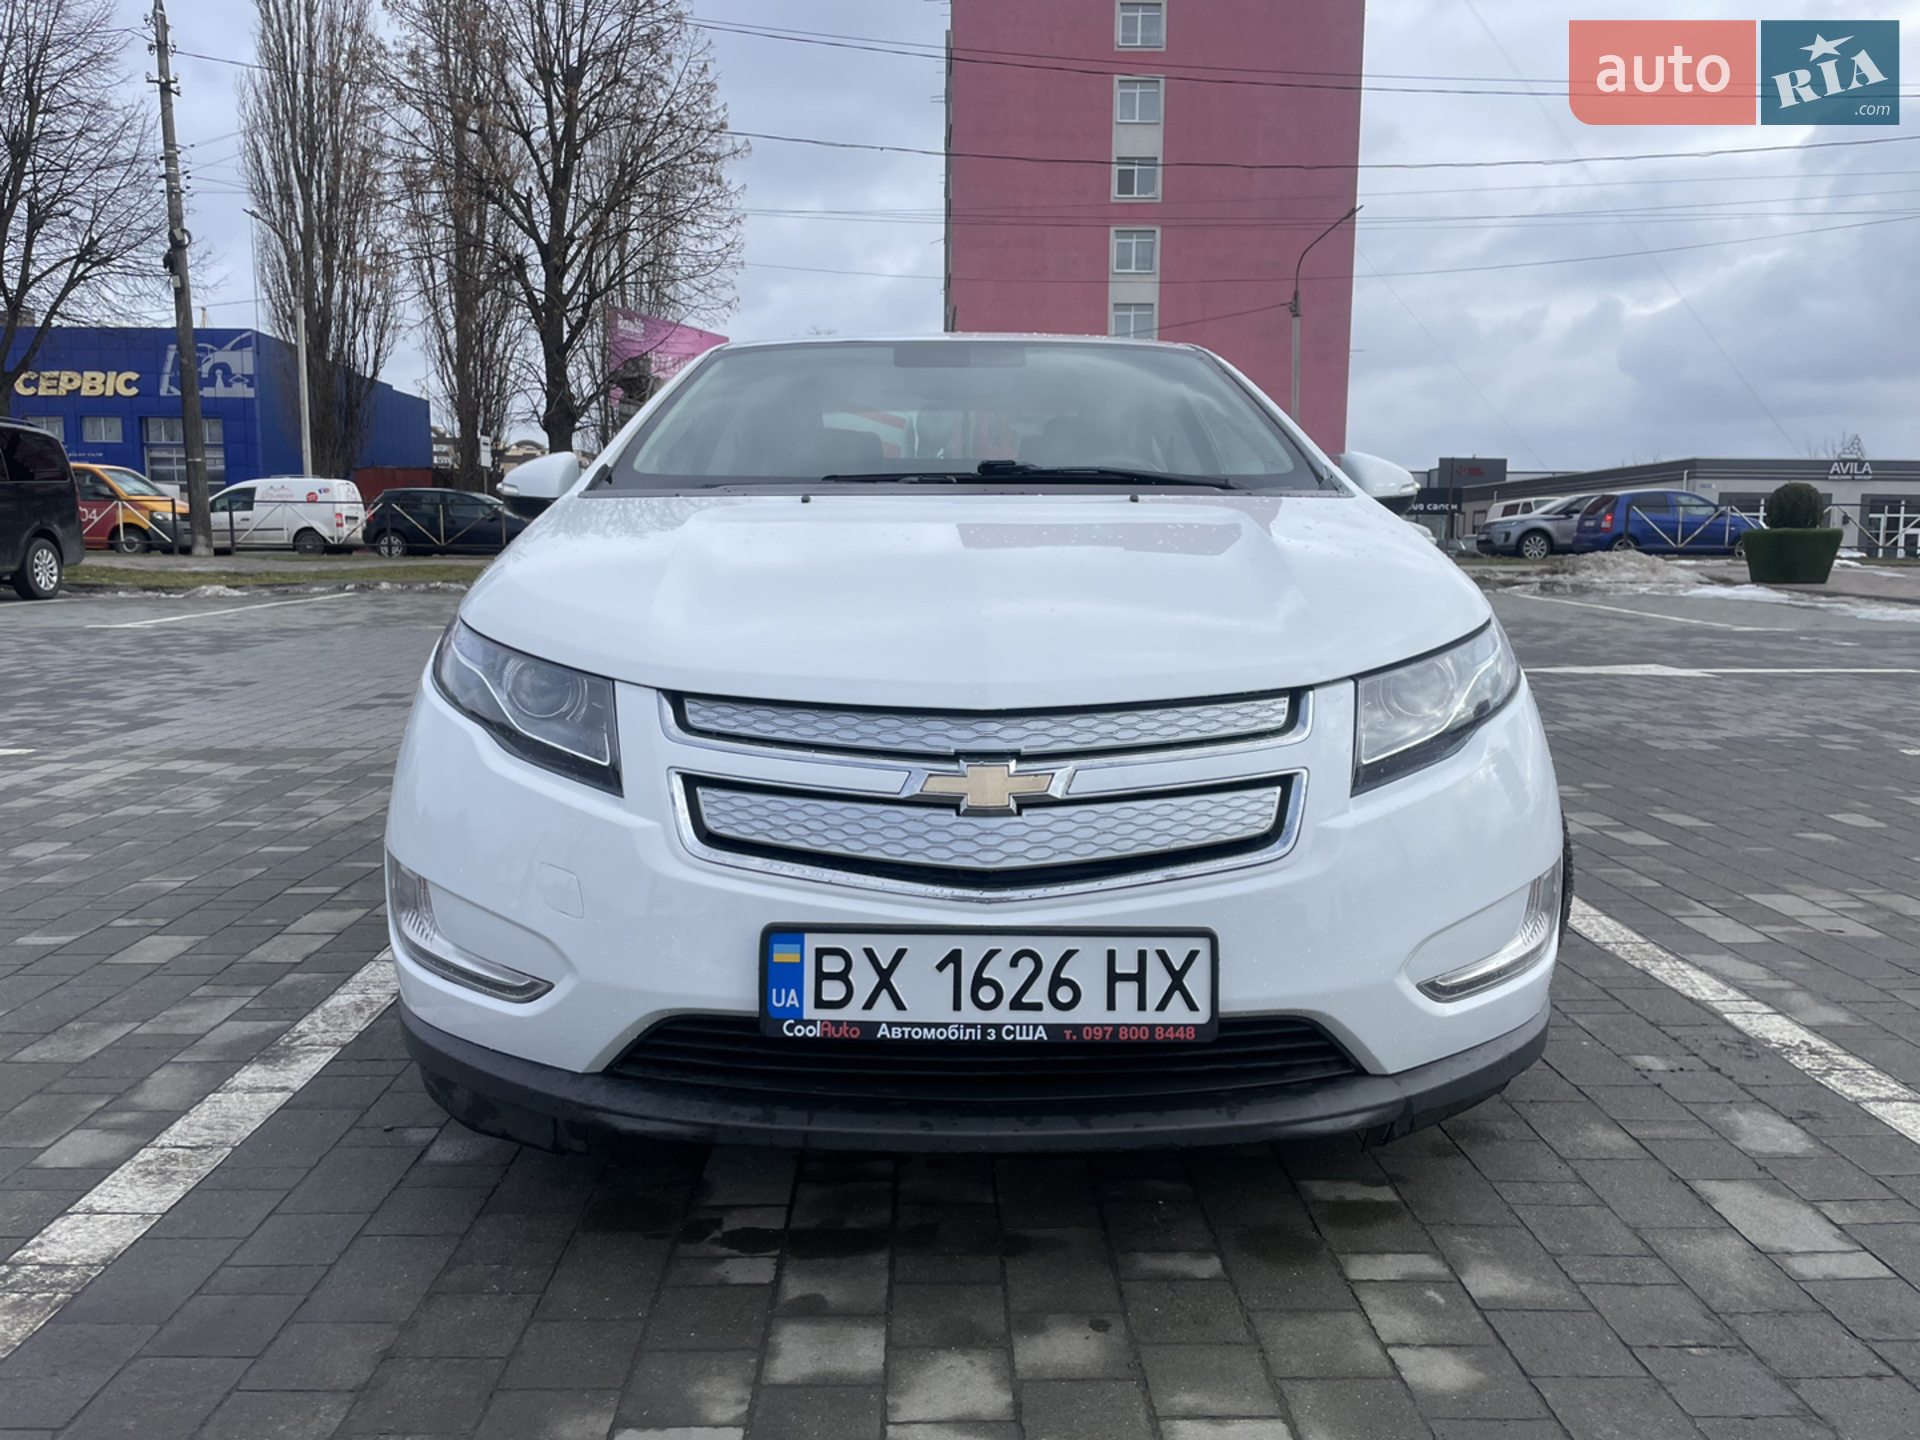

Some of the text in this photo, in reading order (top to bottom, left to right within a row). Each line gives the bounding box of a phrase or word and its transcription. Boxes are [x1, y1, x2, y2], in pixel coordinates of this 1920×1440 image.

[14, 370, 141, 398] СЕРВІС
[1828, 462, 1873, 474] AVILA
[814, 946, 1201, 1013] BX 1626 HX
[771, 988, 800, 1008] UA
[876, 1023, 1049, 1041] Автомобілі з США
[1063, 1026, 1196, 1041] т. 097 800 8448
